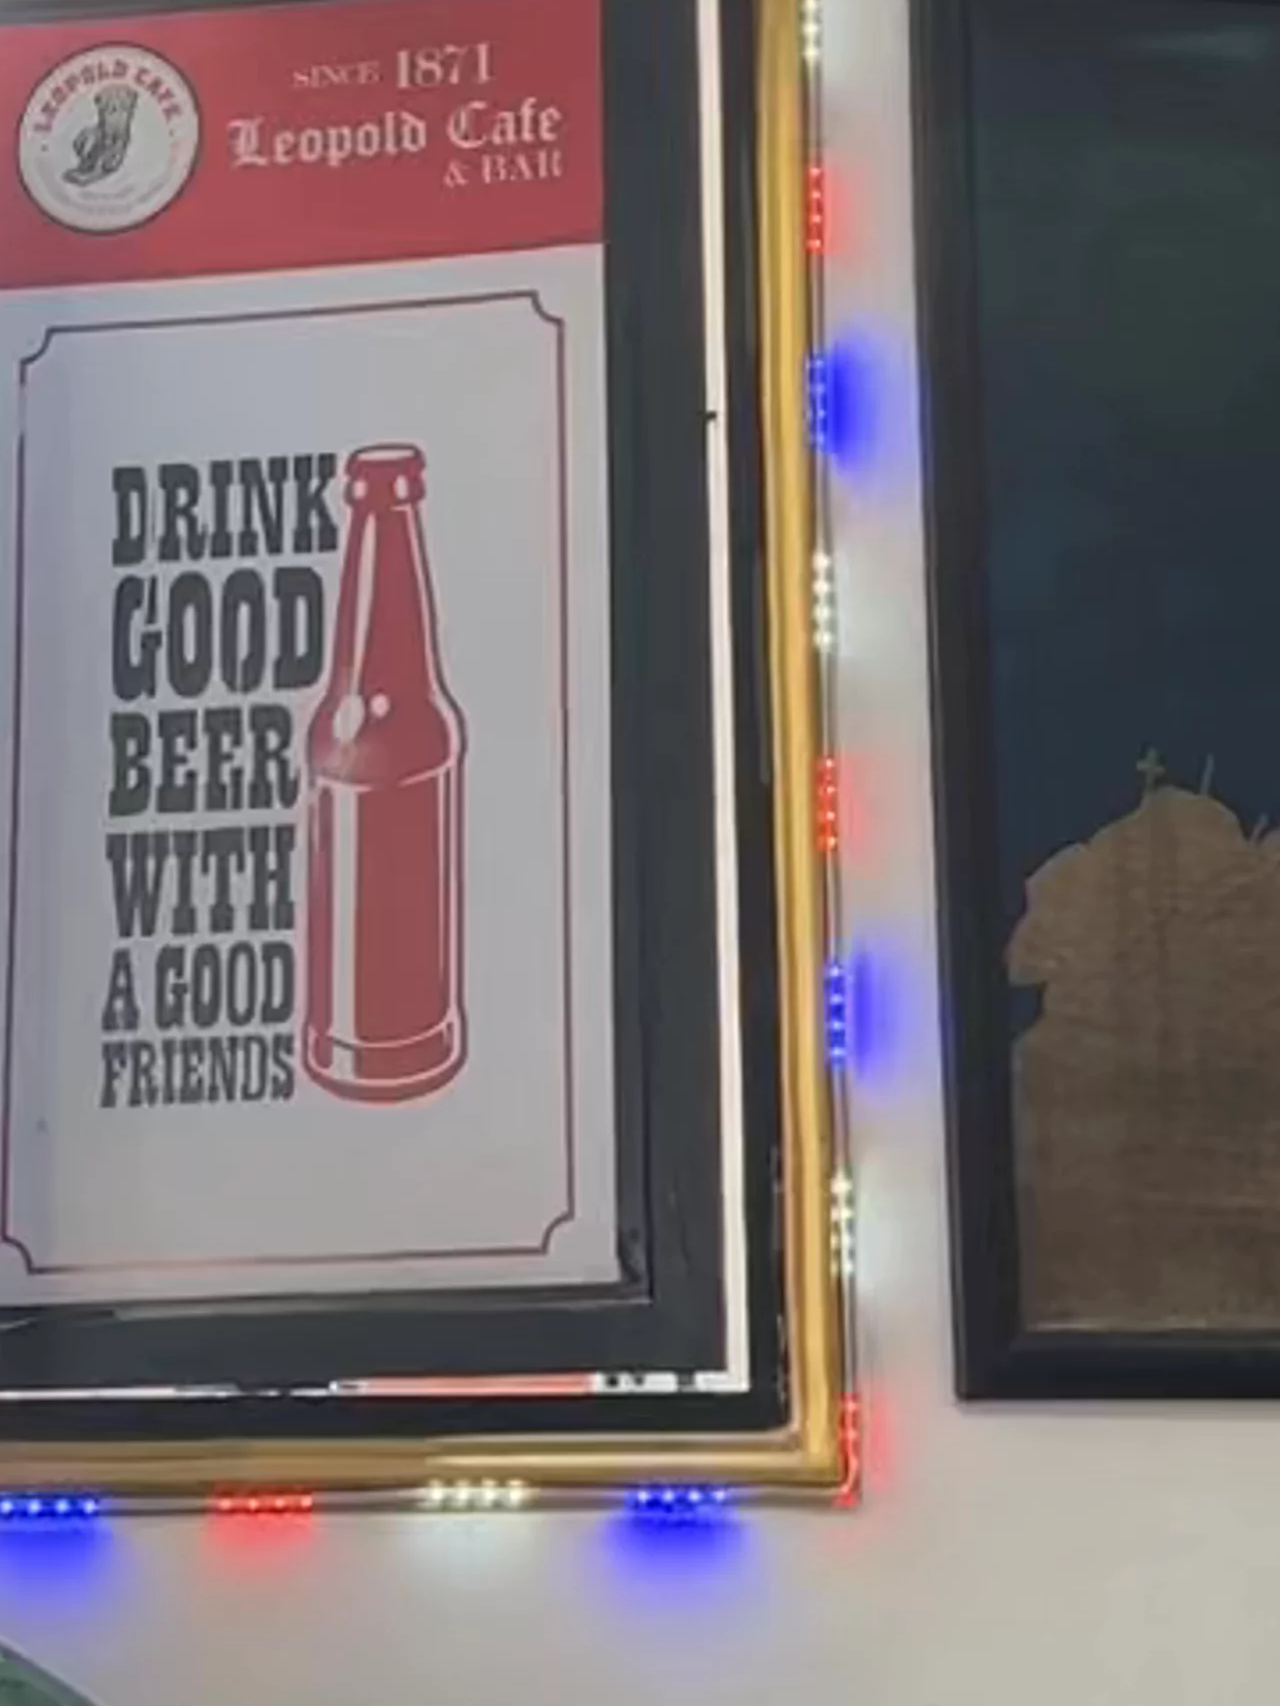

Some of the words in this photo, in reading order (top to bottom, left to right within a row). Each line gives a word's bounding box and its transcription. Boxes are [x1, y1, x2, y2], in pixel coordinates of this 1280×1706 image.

[396, 42, 493, 88] 1871
[226, 111, 427, 168] Leopold
[447, 97, 563, 148] Cafe
[443, 160, 470, 188] &
[482, 150, 563, 184] BAR
[112, 453, 338, 566] DRINK
[112, 567, 325, 702] GOOD
[109, 704, 302, 818] BEER
[106, 824, 296, 938] WITH
[101, 947, 140, 1031] A
[155, 941, 295, 1030] GOOD
[99, 1033, 296, 1108] FRIENDS
